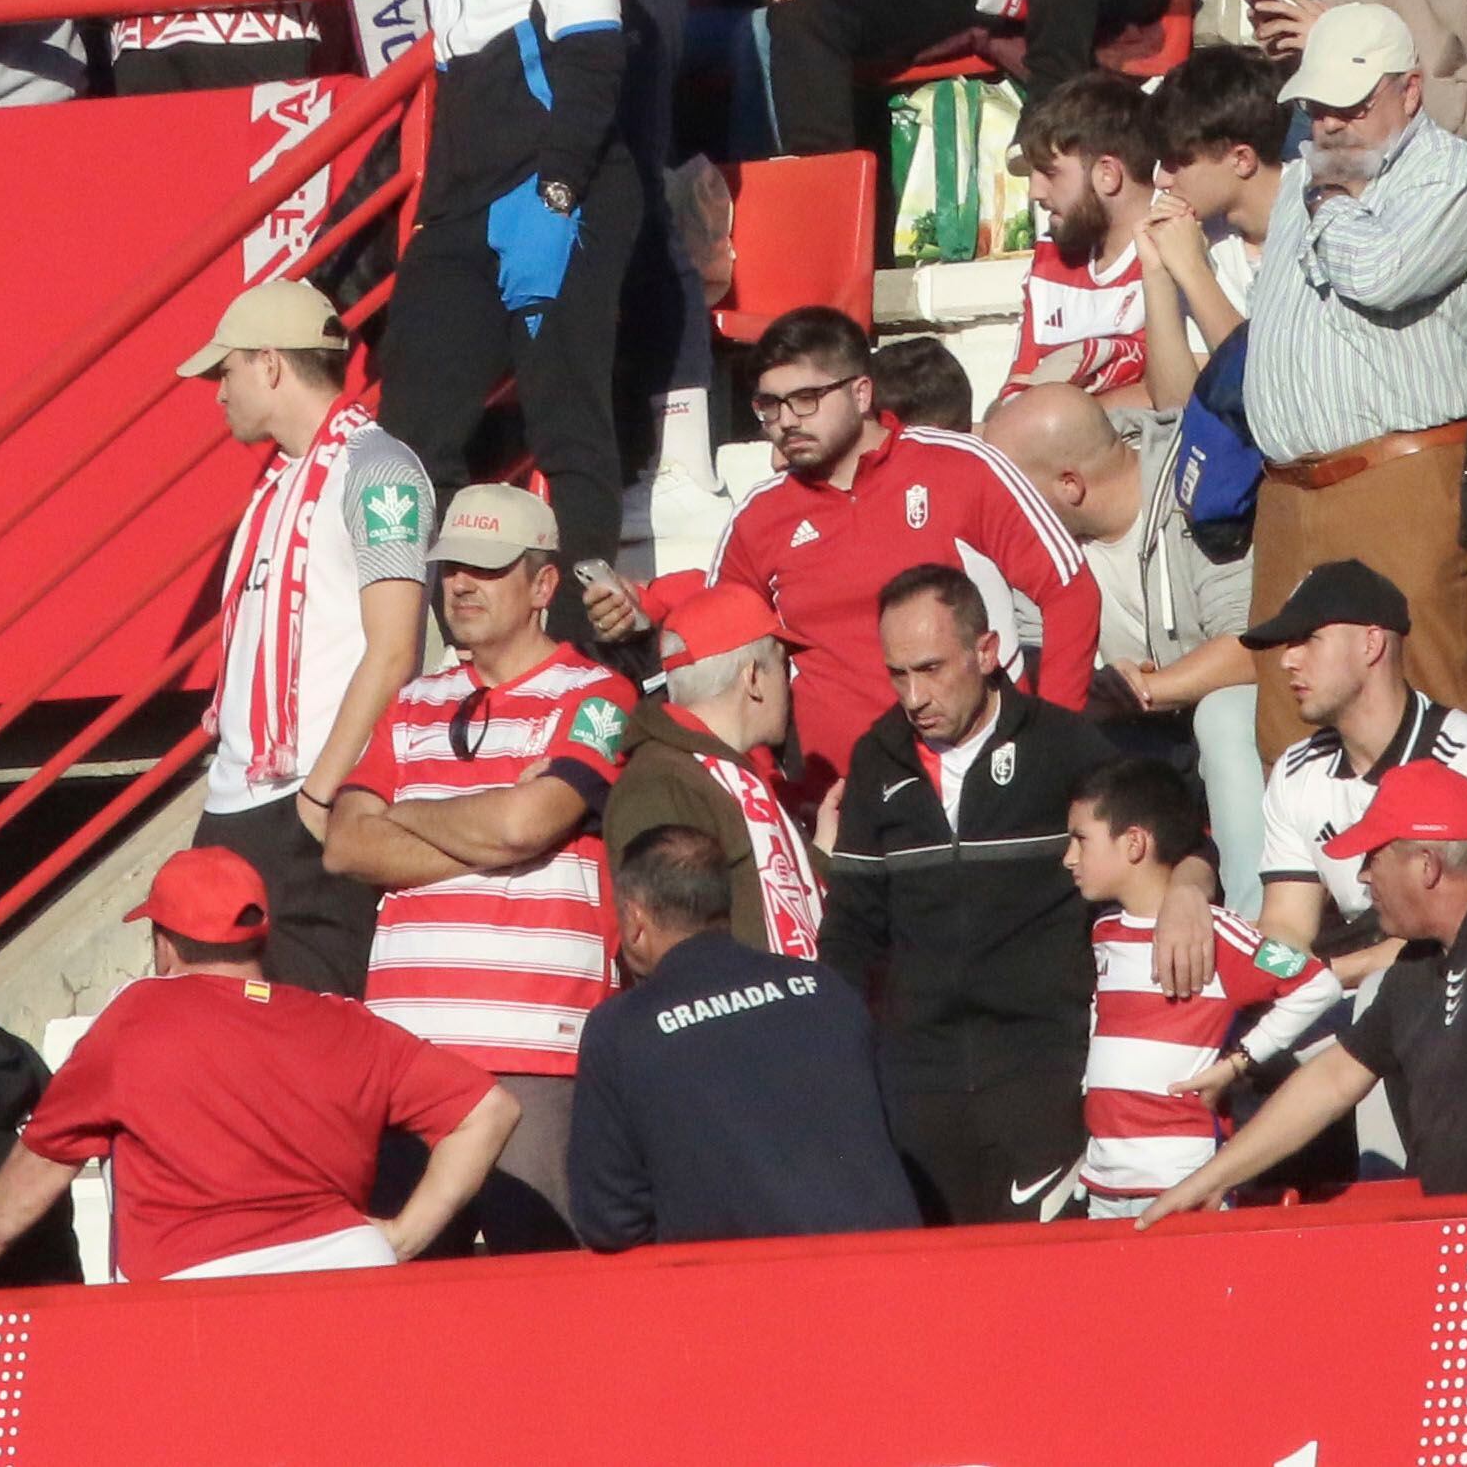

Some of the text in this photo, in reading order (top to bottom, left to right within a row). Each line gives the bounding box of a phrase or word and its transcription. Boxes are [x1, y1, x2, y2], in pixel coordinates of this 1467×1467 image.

[451, 513, 501, 533] LALIGA
[656, 975, 819, 1034] GRANADA CF
